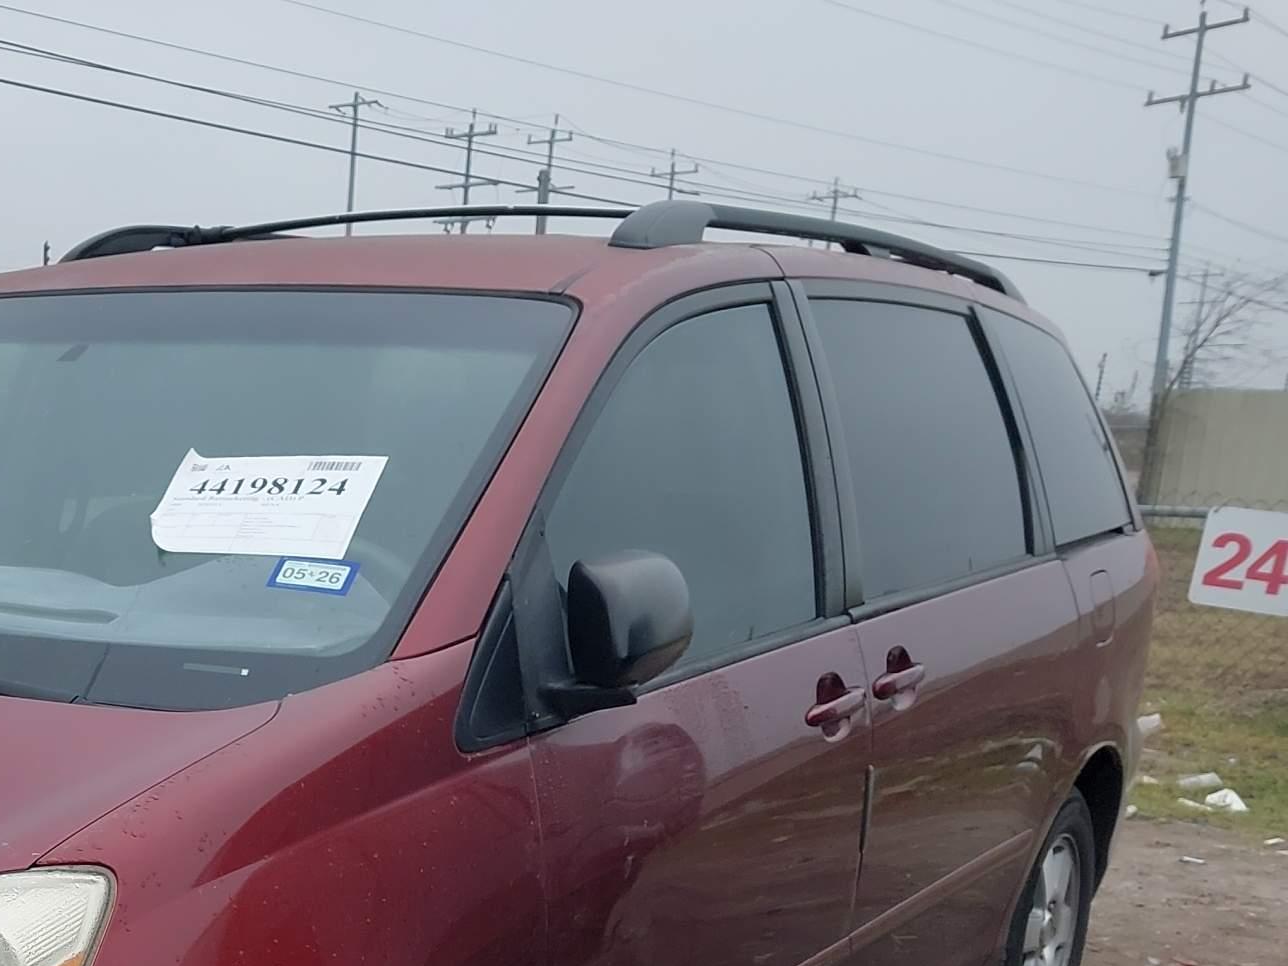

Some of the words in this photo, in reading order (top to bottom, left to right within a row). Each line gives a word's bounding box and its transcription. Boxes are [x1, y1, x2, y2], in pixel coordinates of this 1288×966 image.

[189, 477, 349, 496] 44198124
[1202, 532, 1288, 595] 24
[281, 567, 308, 580] 05
[315, 570, 343, 584] 26
